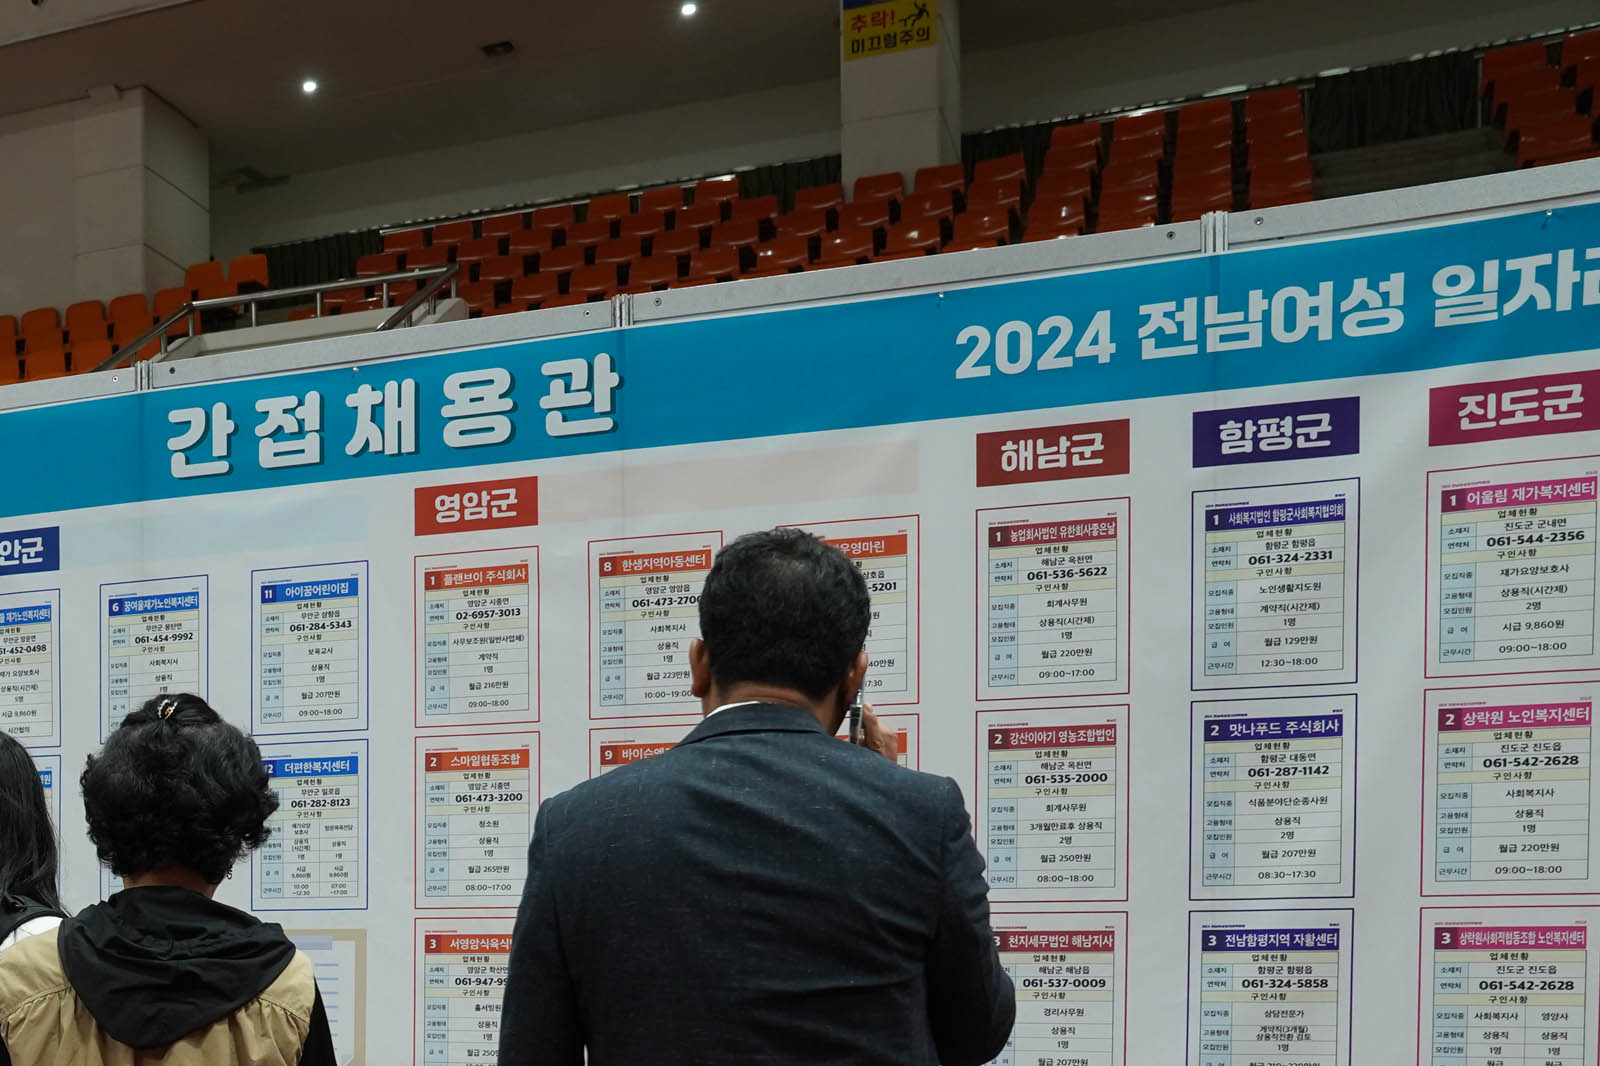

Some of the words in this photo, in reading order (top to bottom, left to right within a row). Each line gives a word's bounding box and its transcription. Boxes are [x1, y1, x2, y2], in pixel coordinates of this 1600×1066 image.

[851, 10, 895, 33] 추락!
[852, 27, 930, 54] 미끄럼주의
[955, 309, 1117, 380] 2024
[1138, 272, 1406, 361] 전남여성
[1458, 384, 1585, 430] 진도군
[1219, 412, 1333, 455] 함평군
[1001, 433, 1105, 472] 해남군
[1450, 495, 1456, 506] 1
[1467, 491, 1507, 505] 어울림
[1512, 481, 1595, 501] 재가복지센터
[434, 487, 519, 524] 영암군
[1213, 515, 1219, 525] 1
[1229, 510, 1270, 524] 사회복지법인
[1272, 504, 1343, 522] 함평군사회복지협의회
[995, 531, 1001, 542] 1
[1010, 528, 1057, 543] 농업회사법인
[1059, 522, 1116, 537] 유한회사좋은날
[1487, 530, 1585, 547] 061-544-2356
[604, 561, 611, 571] 8
[622, 553, 705, 571] 한샘지역아동센터
[1249, 551, 1333, 565] 061-324-2331
[431, 576, 435, 585] 1
[443, 572, 483, 586] 플랜브이
[486, 568, 526, 582] 주식회사
[1027, 567, 1107, 581] 061-536-5622
[1500, 564, 1569, 577] 재가요양보호사
[265, 590, 272, 598] 11
[285, 582, 349, 597] 아이꿈어린이집
[1259, 582, 1321, 594] 노인생활지도원
[113, 602, 118, 611] 6
[1047, 598, 1088, 608] 회계사무원
[456, 609, 521, 620] 02-6957-3013
[290, 620, 352, 632] 061-284-5343
[1503, 623, 1521, 632] 시급
[1525, 620, 1564, 631] 9,860원
[135, 633, 193, 644] 061-454-9992
[1499, 642, 1567, 653] 09:00~18:00
[1261, 658, 1318, 667] 12:30~18:00
[1039, 669, 1095, 678] 09:00~17:00
[1445, 715, 1455, 725] 2
[1464, 712, 1504, 725] 상락원
[1508, 708, 1590, 723] 노인복지센터
[1211, 726, 1219, 736] 2
[1230, 723, 1281, 736] 맛나푸드
[1285, 720, 1338, 733] 주식회사
[994, 734, 1002, 744] 2
[1010, 732, 1056, 745] 강산이야기
[1058, 728, 1115, 742] 영농조합법인
[285, 760, 350, 773] 더편한복지센터
[430, 758, 436, 767] 2
[450, 754, 520, 767] 스마일협동조합
[1483, 755, 1579, 768] 061-542-2628
[1248, 766, 1329, 777] 061-287-1142
[1025, 773, 1107, 784] 061-535-2000
[291, 799, 350, 808] 061-282-8123
[456, 793, 522, 802] 061-473-3200
[1009, 935, 1069, 947] 천지세무법인
[1072, 935, 1113, 947] 해남지사
[1208, 936, 1216, 946] 3
[1225, 934, 1290, 947] 전남함평지역
[1293, 933, 1337, 946] 자활센터
[1441, 933, 1451, 943] 3
[1538, 932, 1584, 944] 노인복지센터
[1023, 979, 1106, 988] 061-537-0009
[1242, 979, 1328, 988] 061-324-5858
[1479, 981, 1574, 990] 061-542-2628
[1044, 1008, 1084, 1016] 경리사무원
